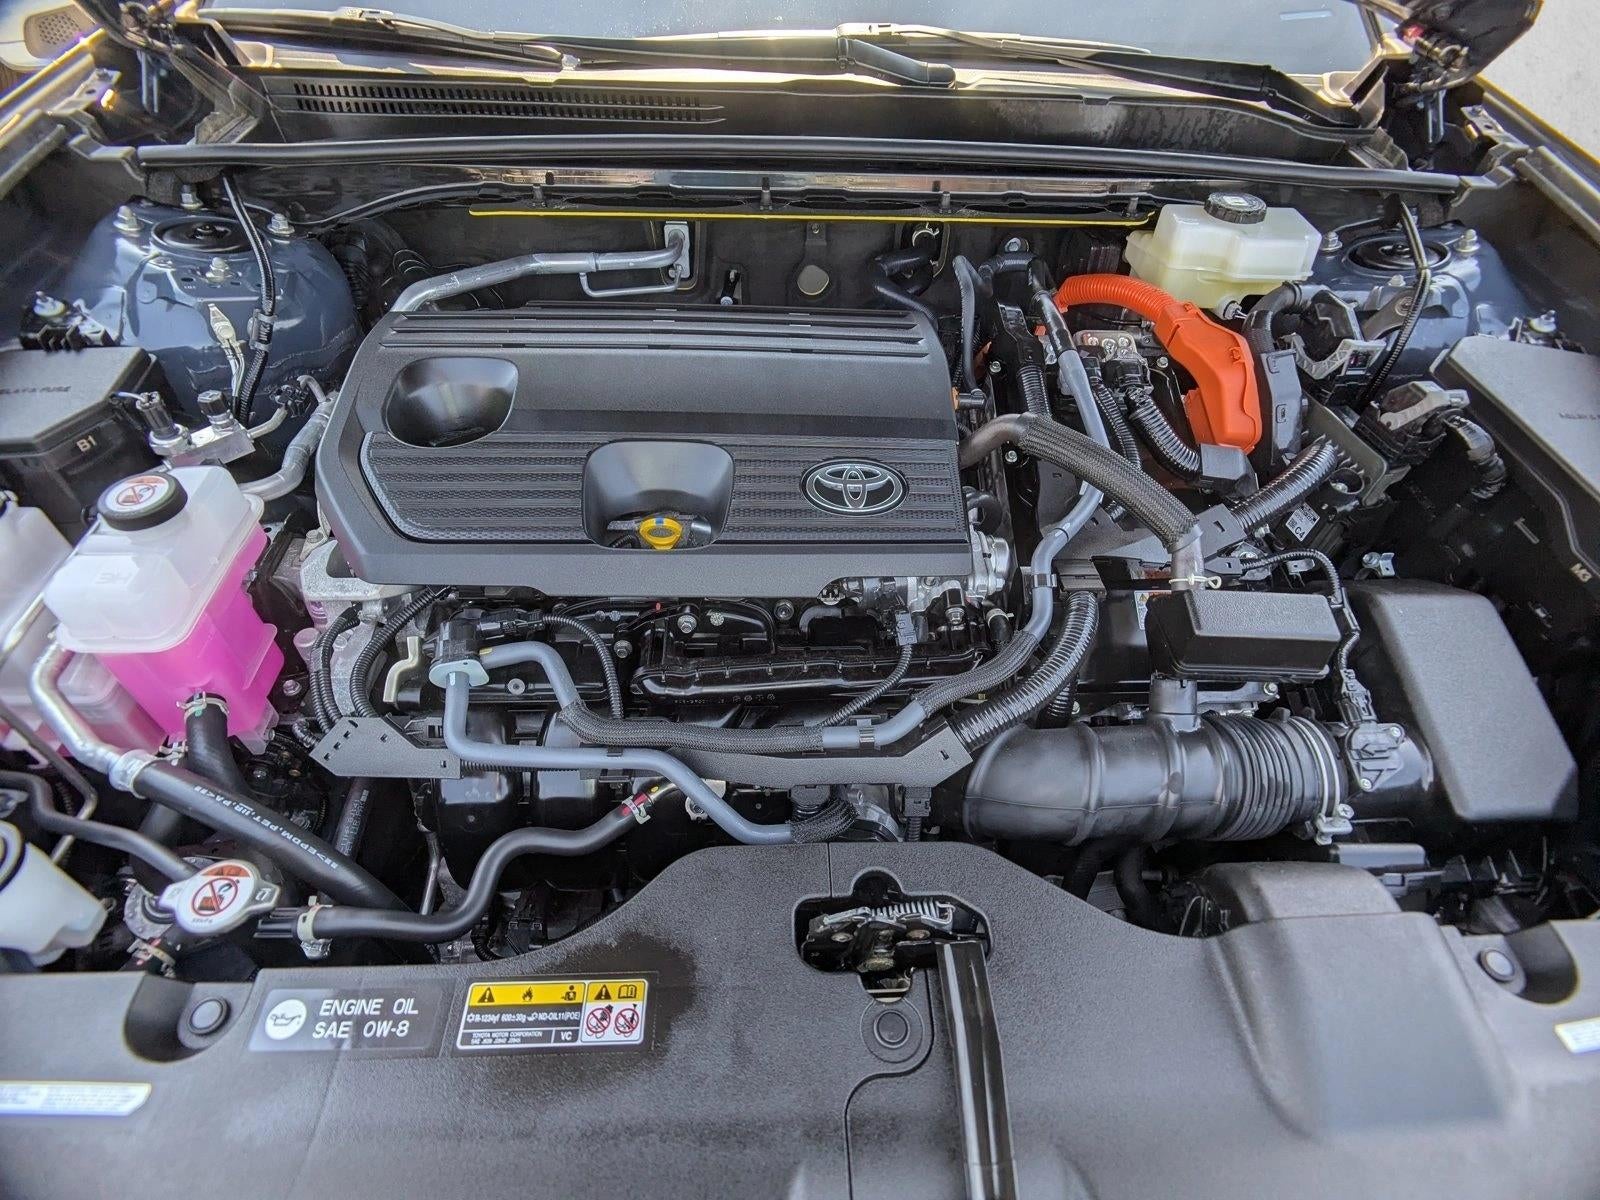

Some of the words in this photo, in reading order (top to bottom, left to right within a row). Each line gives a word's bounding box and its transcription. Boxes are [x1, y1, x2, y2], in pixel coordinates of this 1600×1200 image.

[76, 435, 97, 452] B1
[319, 999, 384, 1017] ENGINE
[392, 998, 419, 1015] OIL
[312, 1021, 353, 1039] SAE
[362, 1019, 410, 1039] 0W-8
[560, 1031, 573, 1041] VC
